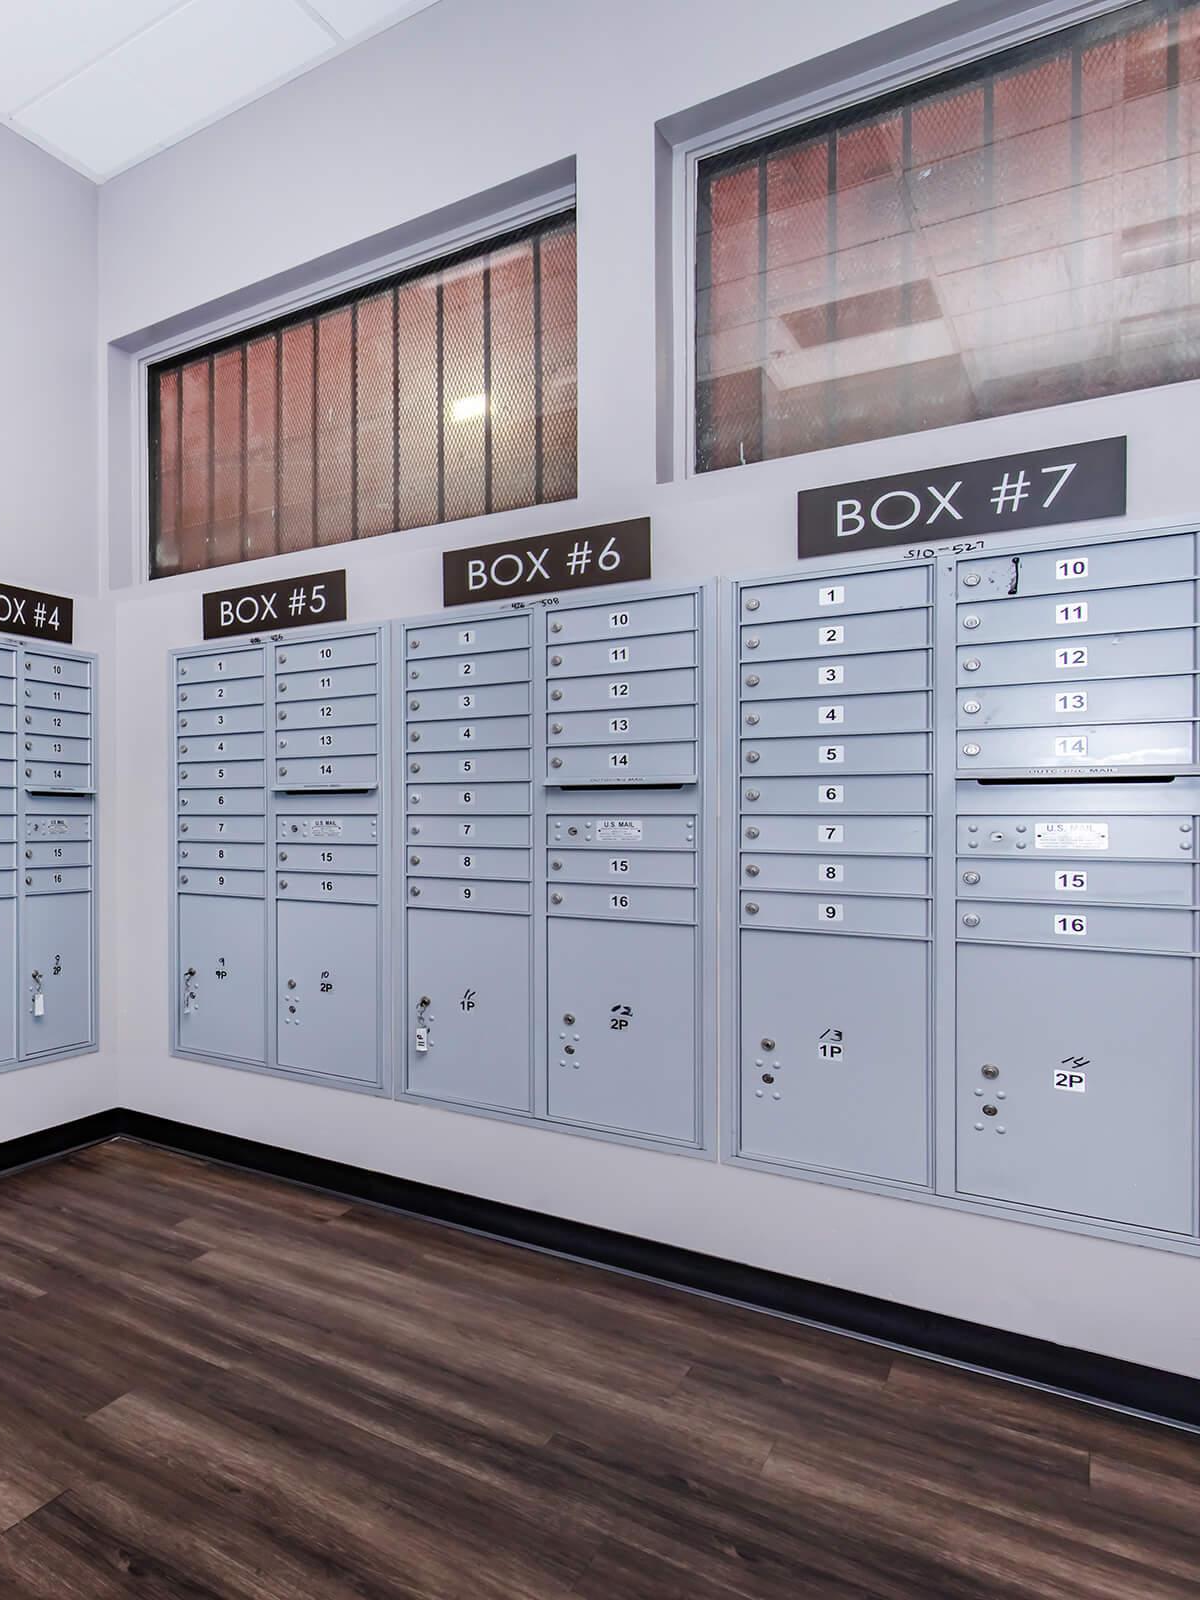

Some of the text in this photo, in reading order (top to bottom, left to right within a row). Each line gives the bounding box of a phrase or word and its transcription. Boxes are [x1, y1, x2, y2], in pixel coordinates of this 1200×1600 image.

[836, 463, 1077, 537] BOX #7
[468, 537, 621, 591] BOX #6
[1059, 561, 1086, 577] 10
[827, 589, 835, 602] 1
[220, 584, 326, 627] BOX #5
[33, 602, 60, 631] #4
[611, 614, 629, 626] 10
[1060, 606, 1082, 621] 11
[826, 629, 837, 642] 2
[320, 648, 332, 659] 10
[611, 648, 626, 661] 11
[1059, 650, 1086, 665] 12
[53, 665, 62, 675] 10
[463, 663, 471, 675] 2
[826, 668, 837, 682] 3
[320, 677, 331, 688] 11
[53, 691, 61, 701] 11
[611, 684, 628, 697] 12
[463, 696, 471, 707] 3
[1058, 695, 1085, 710] 13
[320, 706, 332, 717] 12
[825, 708, 837, 721] 4
[53, 718, 62, 727] 12
[611, 719, 628, 731] 13
[463, 728, 472, 739] 4
[320, 735, 333, 746] 13
[1059, 739, 1085, 753] 14
[53, 743, 62, 753] 13
[826, 748, 837, 761] 5
[464, 761, 472, 772] 5
[611, 754, 628, 767] 14
[53, 770, 62, 779] 14
[320, 765, 332, 775] 14
[463, 792, 471, 803] 6
[826, 787, 837, 801] 6
[463, 824, 472, 835] 7
[825, 827, 836, 840] 7
[54, 848, 63, 858] 15
[321, 852, 333, 863] 15
[463, 856, 471, 867] 8
[611, 860, 629, 872] 15
[54, 874, 62, 884] 16
[826, 866, 836, 880] 8
[321, 881, 333, 891] 16
[1058, 874, 1085, 888] 15
[463, 888, 472, 899] 9
[611, 895, 629, 908] 16
[825, 906, 836, 919] 9
[1058, 917, 1085, 933] 16
[320, 982, 333, 993] 2P
[460, 1000, 476, 1012] 1P
[610, 1018, 629, 1031] 2P
[819, 1028, 843, 1042] 13
[819, 1044, 842, 1058] 1P
[1061, 1056, 1091, 1069] 14
[1055, 1073, 1084, 1088] 2P
